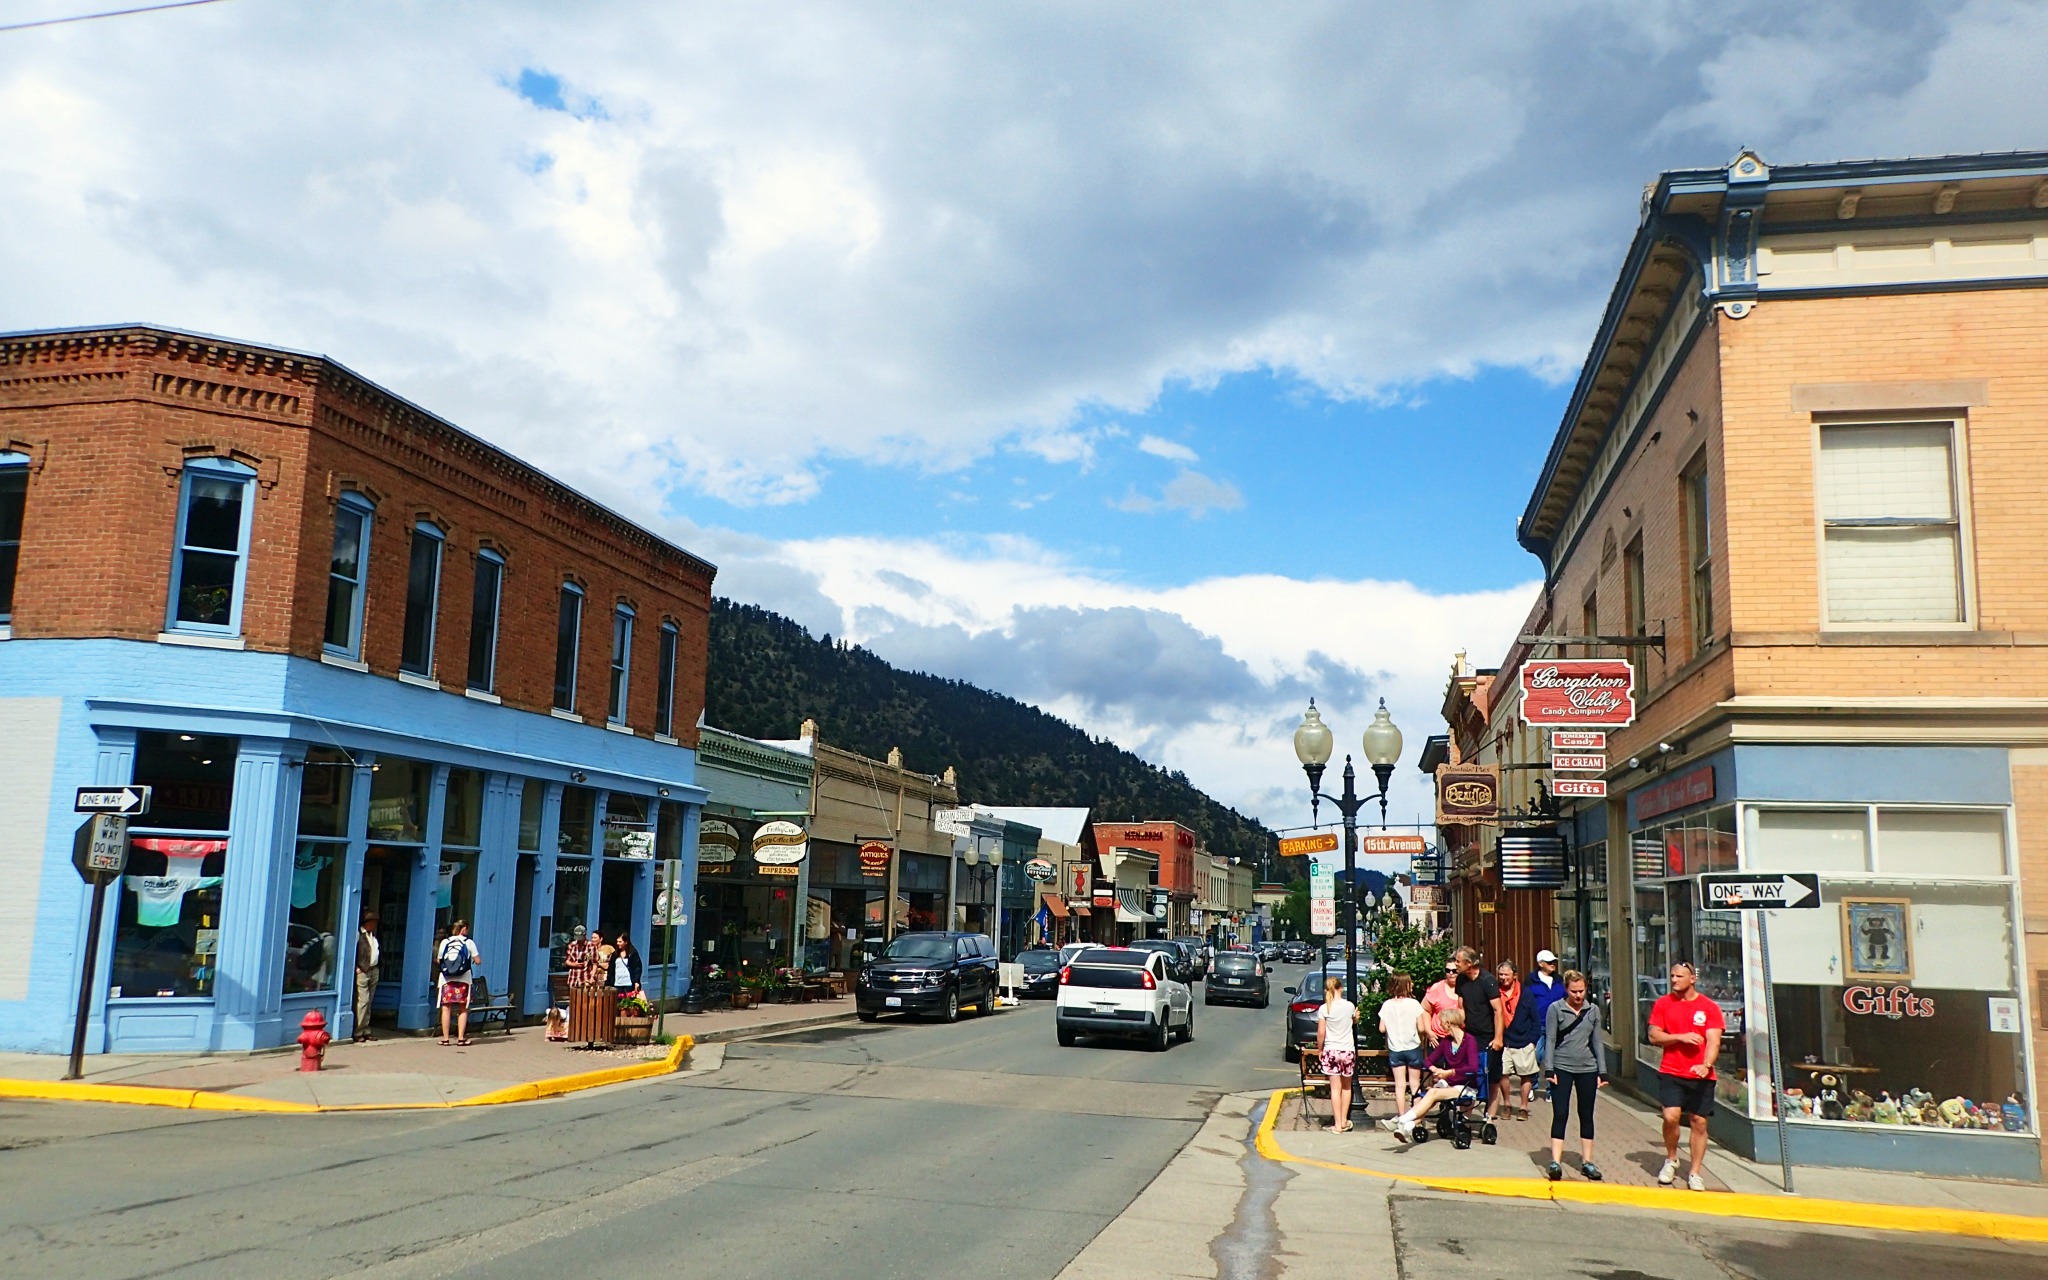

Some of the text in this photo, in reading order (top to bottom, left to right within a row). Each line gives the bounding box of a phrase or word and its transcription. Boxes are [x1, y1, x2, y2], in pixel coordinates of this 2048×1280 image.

[1531, 666, 1627, 696] Georgetown
[1569, 688, 1622, 713] Valley
[1541, 707, 1605, 717] Candy Company
[1562, 738, 1595, 746] Candy
[1556, 757, 1601, 767] ICE CREAM
[1559, 782, 1600, 794] Gifts
[81, 794, 123, 805] ONE WAY
[103, 816, 120, 829] ONE
[102, 829, 119, 841] WAY
[94, 842, 122, 856] DO NOT
[1282, 838, 1323, 853] PARKING
[93, 855, 119, 868] EER
[762, 867, 796, 875] ESPRESSO
[1312, 865, 1318, 876] 3
[1713, 884, 1783, 899] ONE WAY
[1314, 907, 1333, 915] PARKING
[1843, 985, 1935, 1018] Gifts
